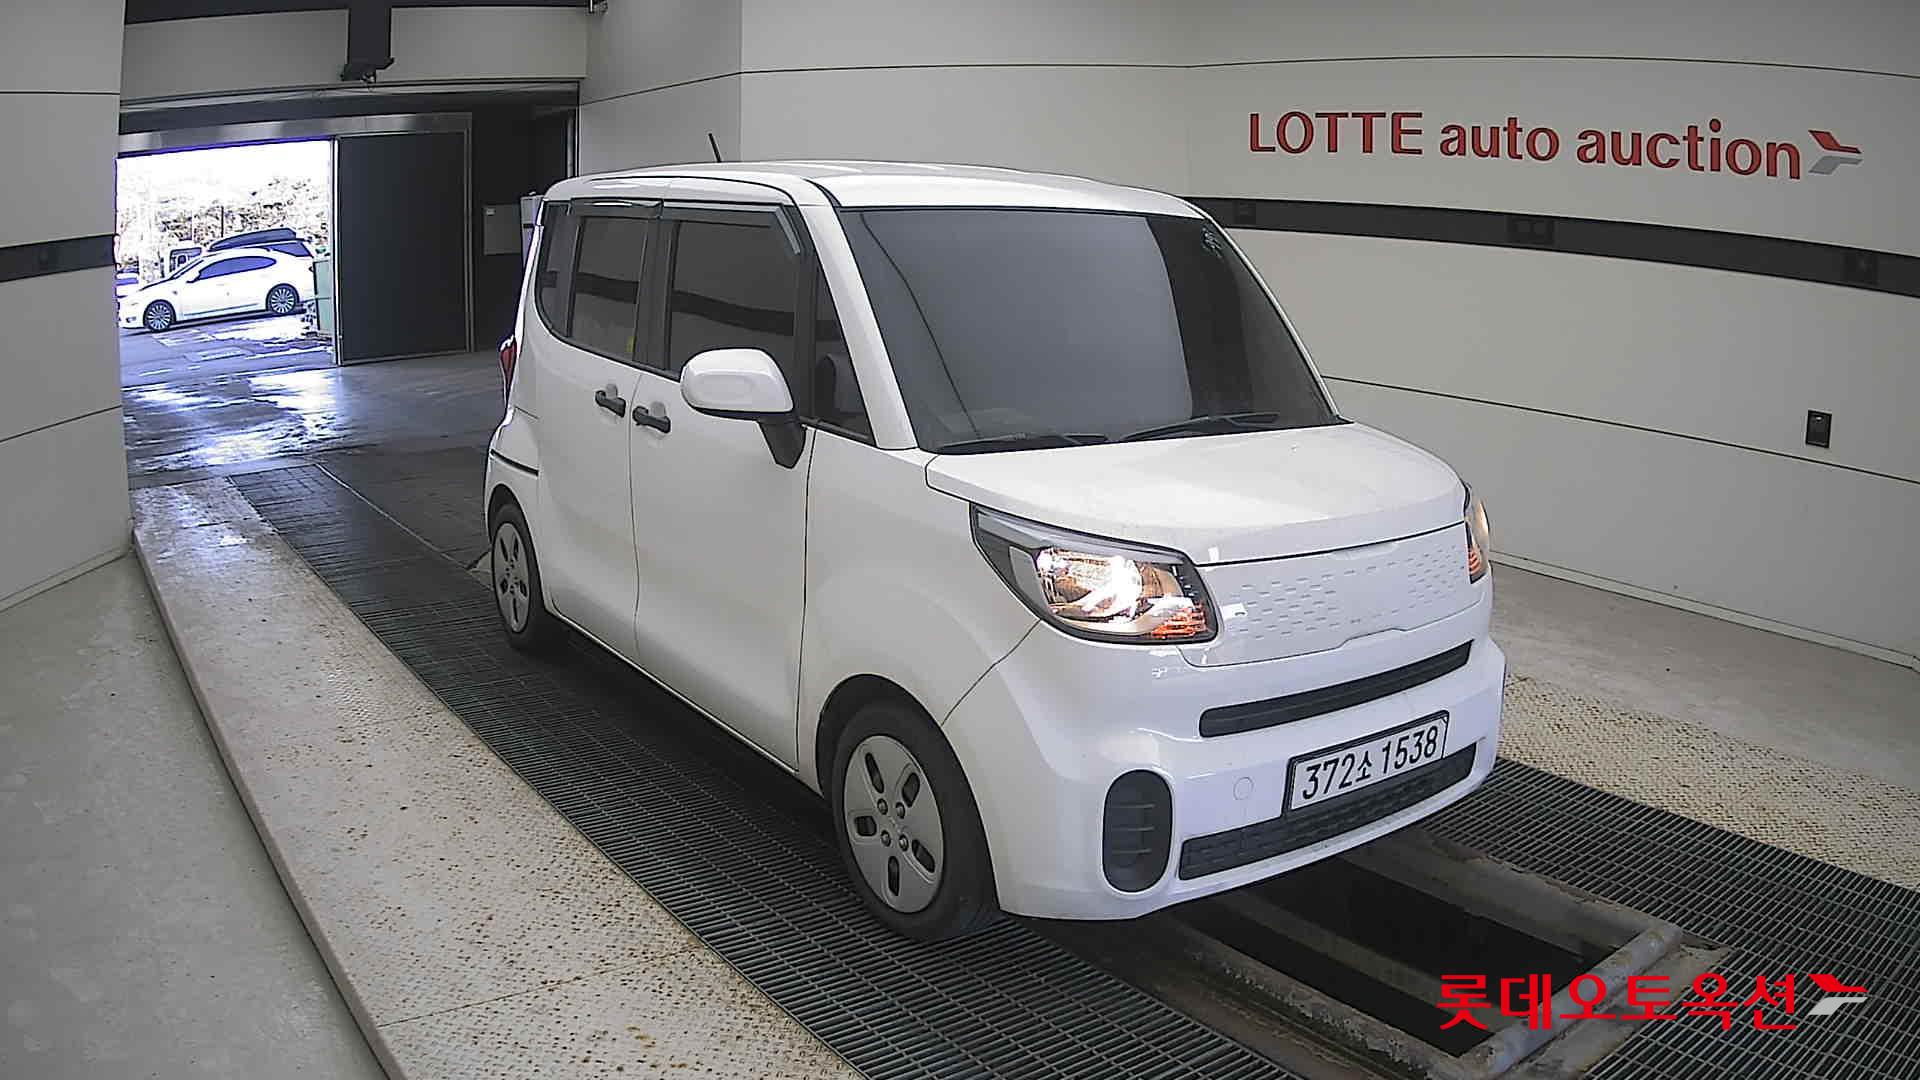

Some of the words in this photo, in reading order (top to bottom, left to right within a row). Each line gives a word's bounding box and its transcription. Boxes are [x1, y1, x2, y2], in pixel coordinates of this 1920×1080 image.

[1249, 112, 1423, 155] LOTTE
[1440, 117, 1560, 161] auto
[1577, 118, 1801, 180] auction
[1302, 750, 1371, 800] 372소
[1382, 726, 1439, 774] 1538
